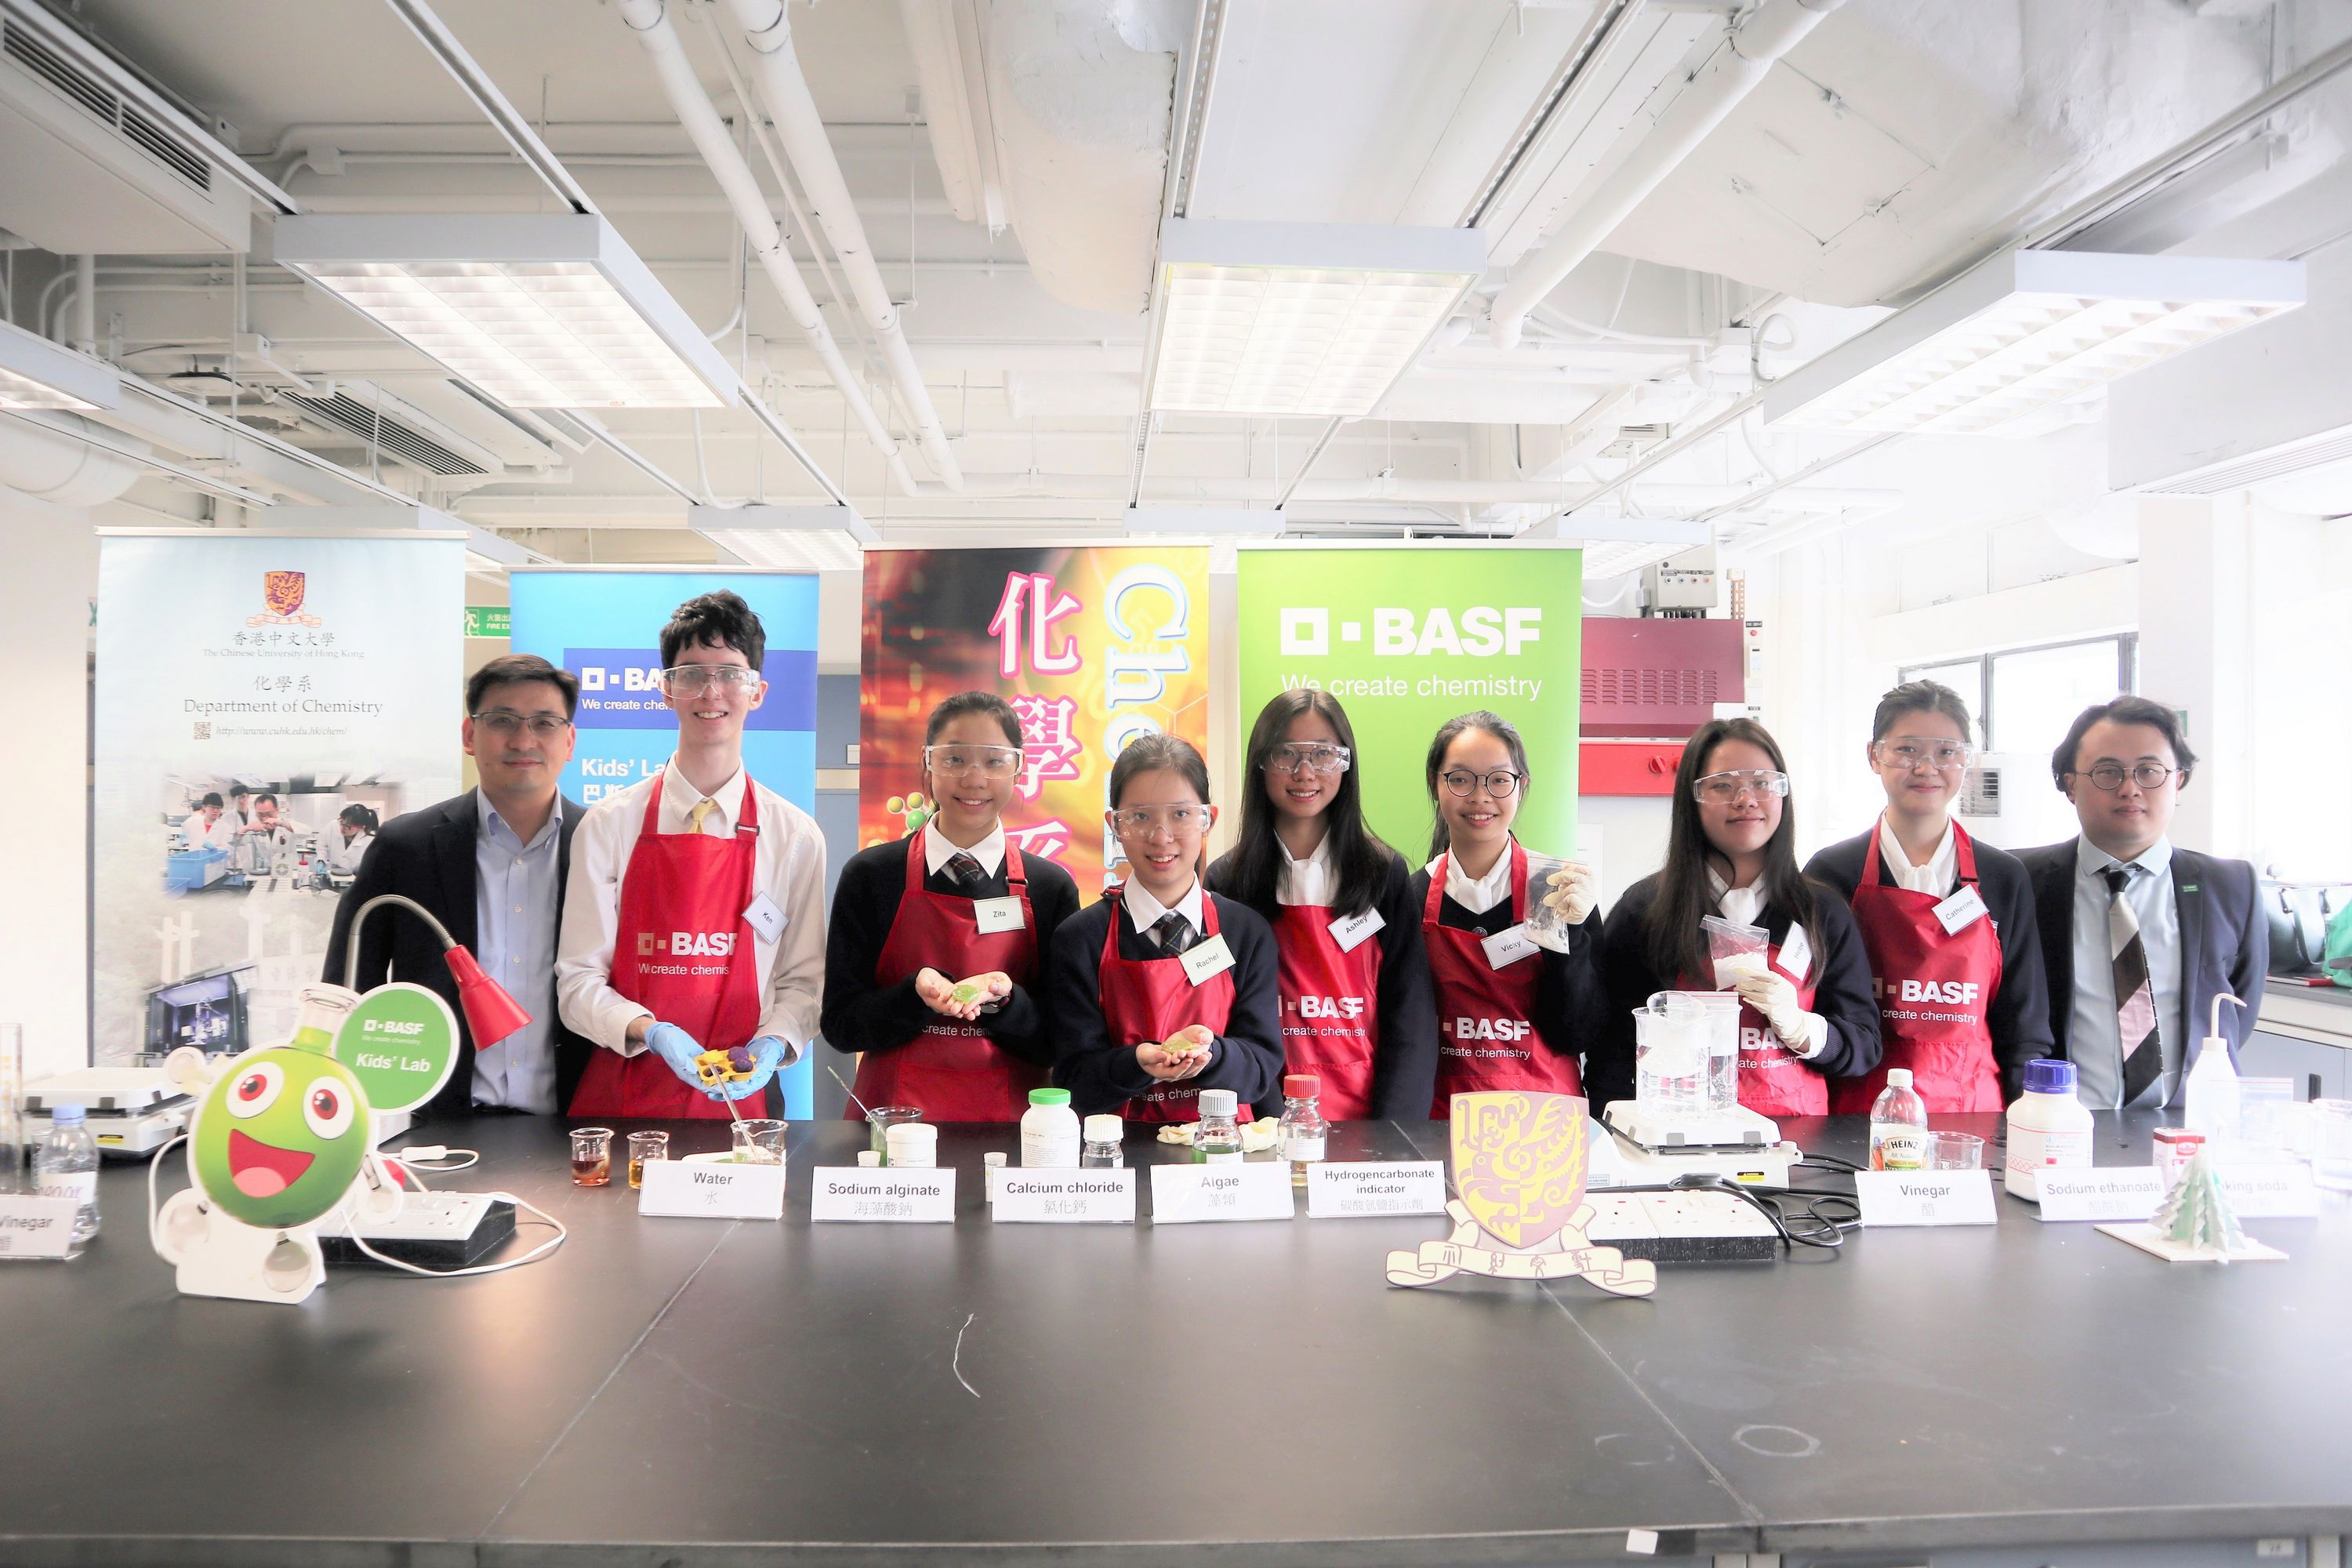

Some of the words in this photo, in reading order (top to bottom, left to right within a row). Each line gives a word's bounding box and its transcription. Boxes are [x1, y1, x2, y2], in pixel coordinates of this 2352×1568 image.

[233, 631, 335, 647] 香港中文大學
[1374, 607, 1542, 656] BASF
[257, 649, 302, 659] University
[315, 649, 339, 659] Hong
[341, 649, 365, 659] Kong
[252, 675, 312, 692] 化學系
[624, 667, 662, 691] BA
[1281, 674, 1320, 695] We
[1329, 673, 1408, 697] create
[1417, 673, 1542, 702] chemistry
[184, 699, 277, 716] Department
[282, 699, 298, 712] of
[303, 699, 383, 717] Chemistry
[582, 699, 601, 710] We
[604, 699, 641, 710] create
[582, 758, 634, 776] Kids'
[641, 759, 666, 776] La
[1945, 898, 1975, 920] Catherine
[762, 911, 773, 924] Ken
[1345, 916, 1368, 934] Ashley
[1501, 941, 1521, 953] Vicky
[1196, 953, 1220, 969] Rachel
[651, 964, 688, 975] create
[691, 964, 729, 975] chemis
[1901, 979, 1979, 1005] BASF
[1301, 996, 1364, 1019] BASF
[1882, 1009, 1918, 1019] create
[1921, 1011, 1977, 1025] chemistry
[383, 1021, 425, 1035] BASF
[1282, 1027, 1317, 1036] create
[1457, 1017, 1530, 1041] BASF
[1740, 1028, 1784, 1050] BA
[1440, 1047, 1472, 1057] create
[1475, 1047, 1530, 1060] chemistry
[356, 1054, 397, 1069] Kids'
[401, 1057, 430, 1073] Lab
[1738, 1058, 1757, 1069] ate
[1891, 1140, 1918, 1149] HEINZ
[694, 1172, 732, 1185] Water
[1201, 1177, 1239, 1189] Algae
[1325, 1170, 1435, 1181] Hydrogencarbonate
[829, 1183, 881, 1195] Sodium
[886, 1184, 940, 1198] alginate
[1007, 1181, 1062, 1193] Calcium
[1067, 1181, 1123, 1193] chloride
[1356, 1185, 1406, 1194] indicator
[1900, 1185, 1951, 1199] Vinegar
[2046, 1183, 2096, 1196] Sodium
[2100, 1181, 2161, 1193] ethanoate
[2220, 1181, 2252, 1193] king
[2256, 1180, 2288, 1192] soda
[704, 1191, 717, 1205] 水
[854, 1201, 913, 1217] 海藻酸鈉
[1921, 1202, 1935, 1217] 醋
